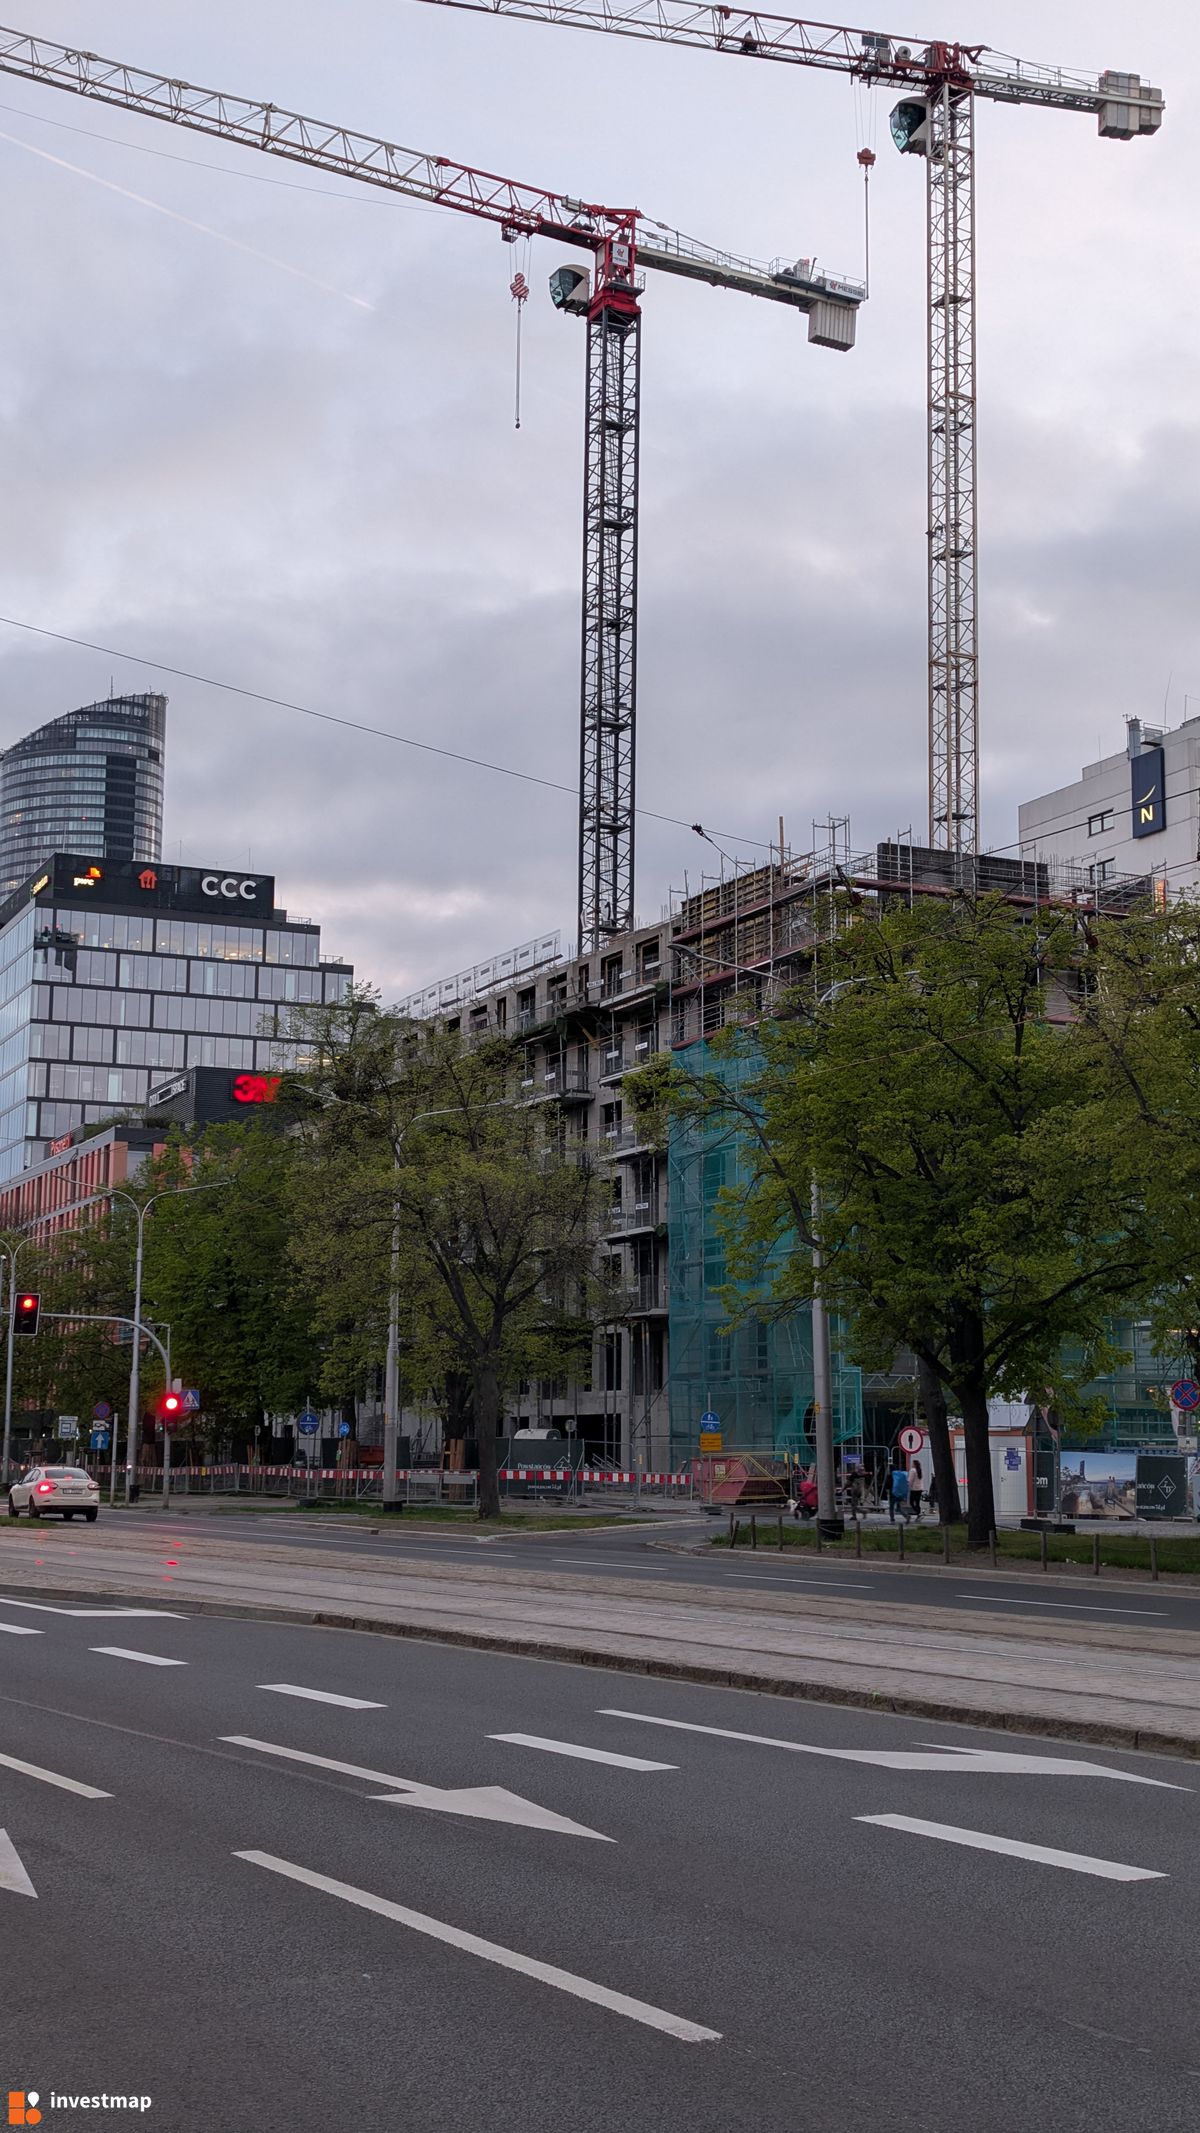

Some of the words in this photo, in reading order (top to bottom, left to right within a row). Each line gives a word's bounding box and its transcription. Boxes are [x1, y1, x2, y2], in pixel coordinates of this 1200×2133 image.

[1140, 804, 1154, 824] N
[73, 877, 95, 887] pwc
[201, 876, 257, 900] CCC
